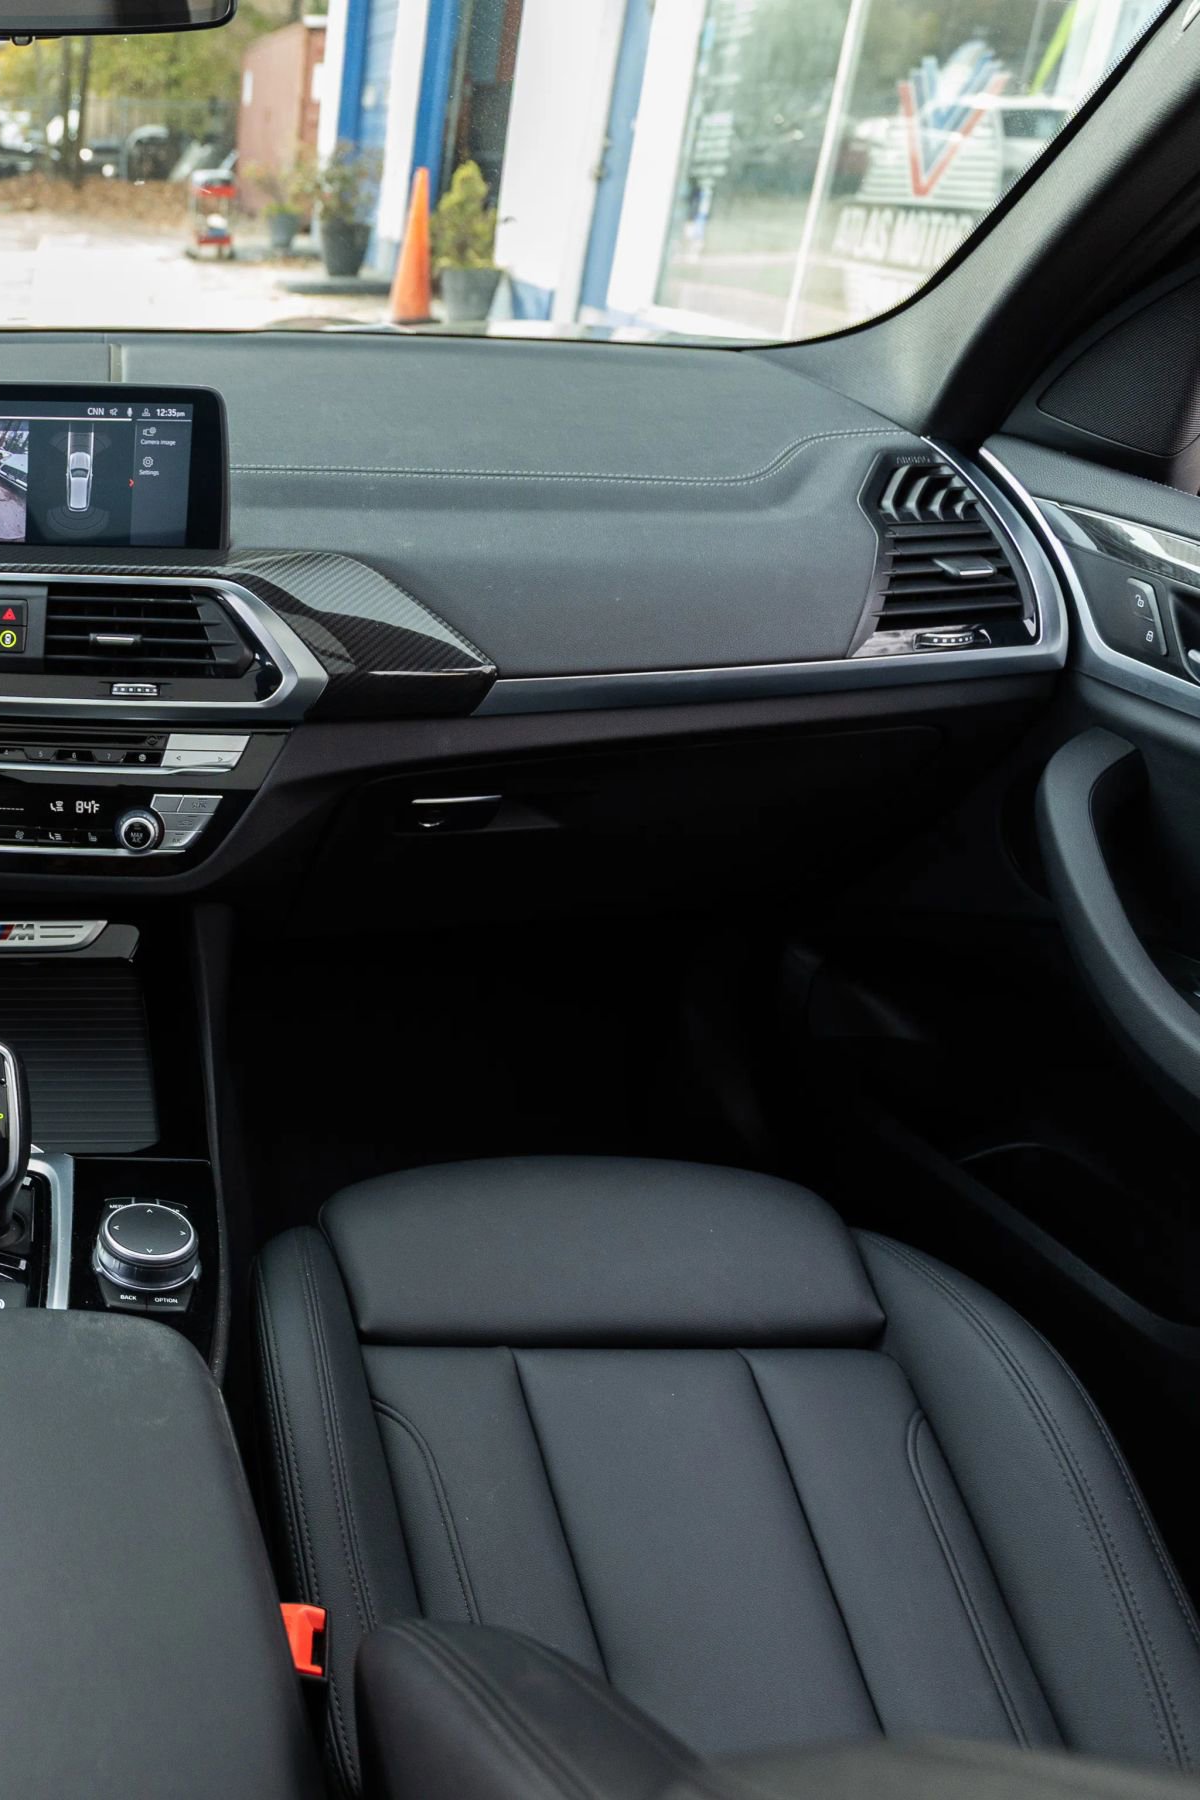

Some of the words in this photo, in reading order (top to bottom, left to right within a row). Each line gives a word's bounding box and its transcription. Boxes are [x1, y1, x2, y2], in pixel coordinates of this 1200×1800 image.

[87, 407, 104, 416] CNN
[156, 408, 177, 417] 12:35
[139, 469, 160, 477] Settings
[7, 923, 35, 941] M
